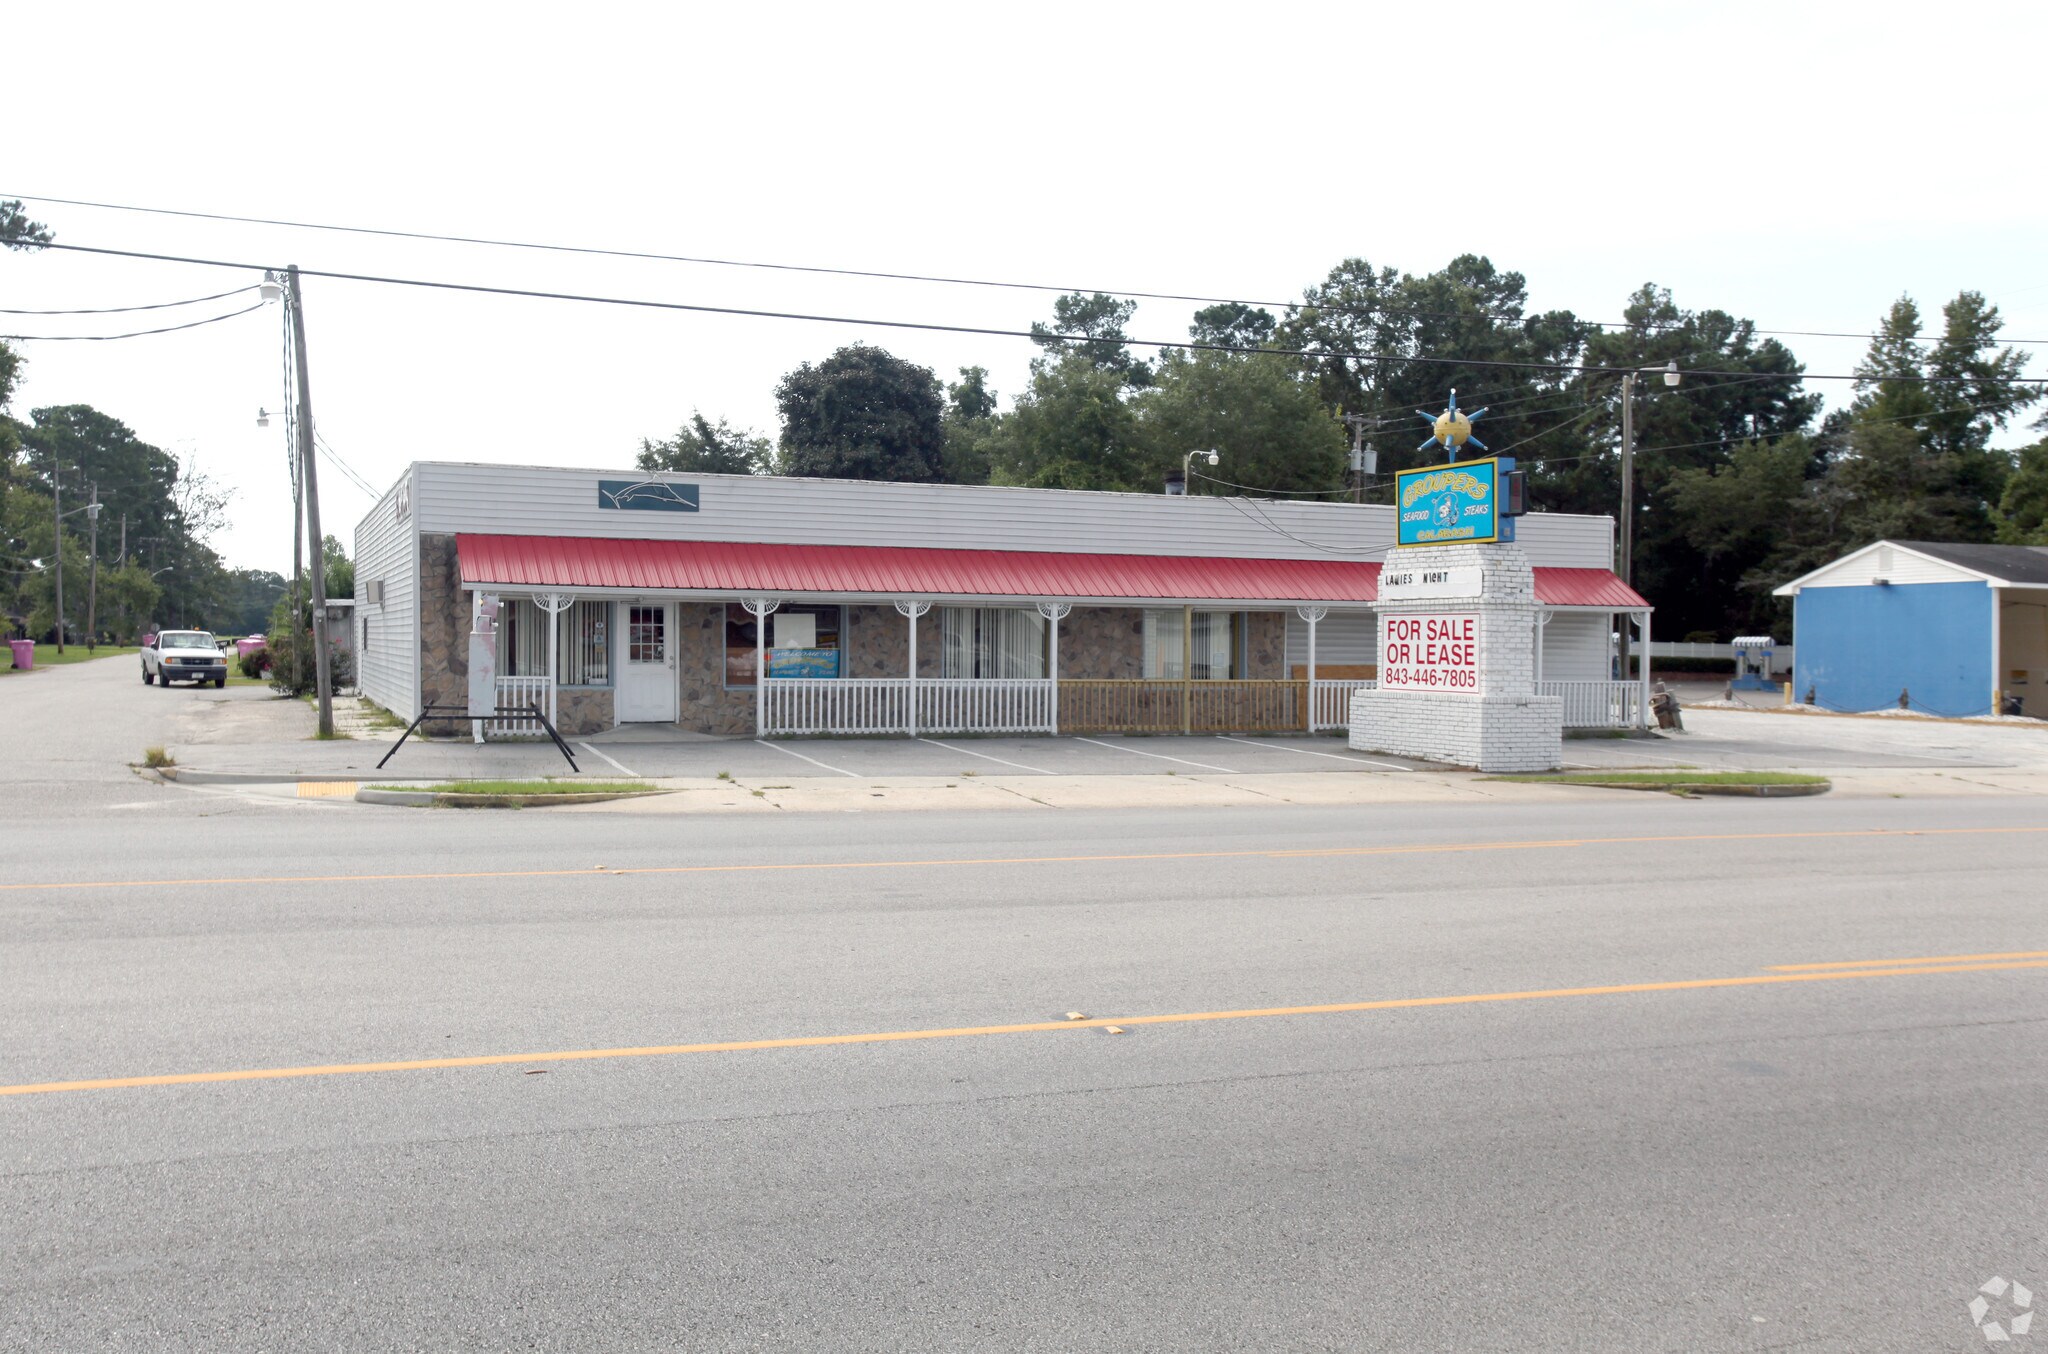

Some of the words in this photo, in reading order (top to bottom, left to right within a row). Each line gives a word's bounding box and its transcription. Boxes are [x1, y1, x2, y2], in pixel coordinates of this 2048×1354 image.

[1403, 472, 1489, 508] GROUPERS
[1402, 510, 1430, 523] SEAFOOD
[1463, 504, 1489, 516] STEAKS
[1416, 526, 1475, 541] CALABASH
[1387, 619, 1421, 641] FOR
[1426, 619, 1474, 641] SALE
[1387, 643, 1411, 665] OR
[1415, 643, 1476, 666] LEASE
[1385, 667, 1476, 688] 843-446-7805
